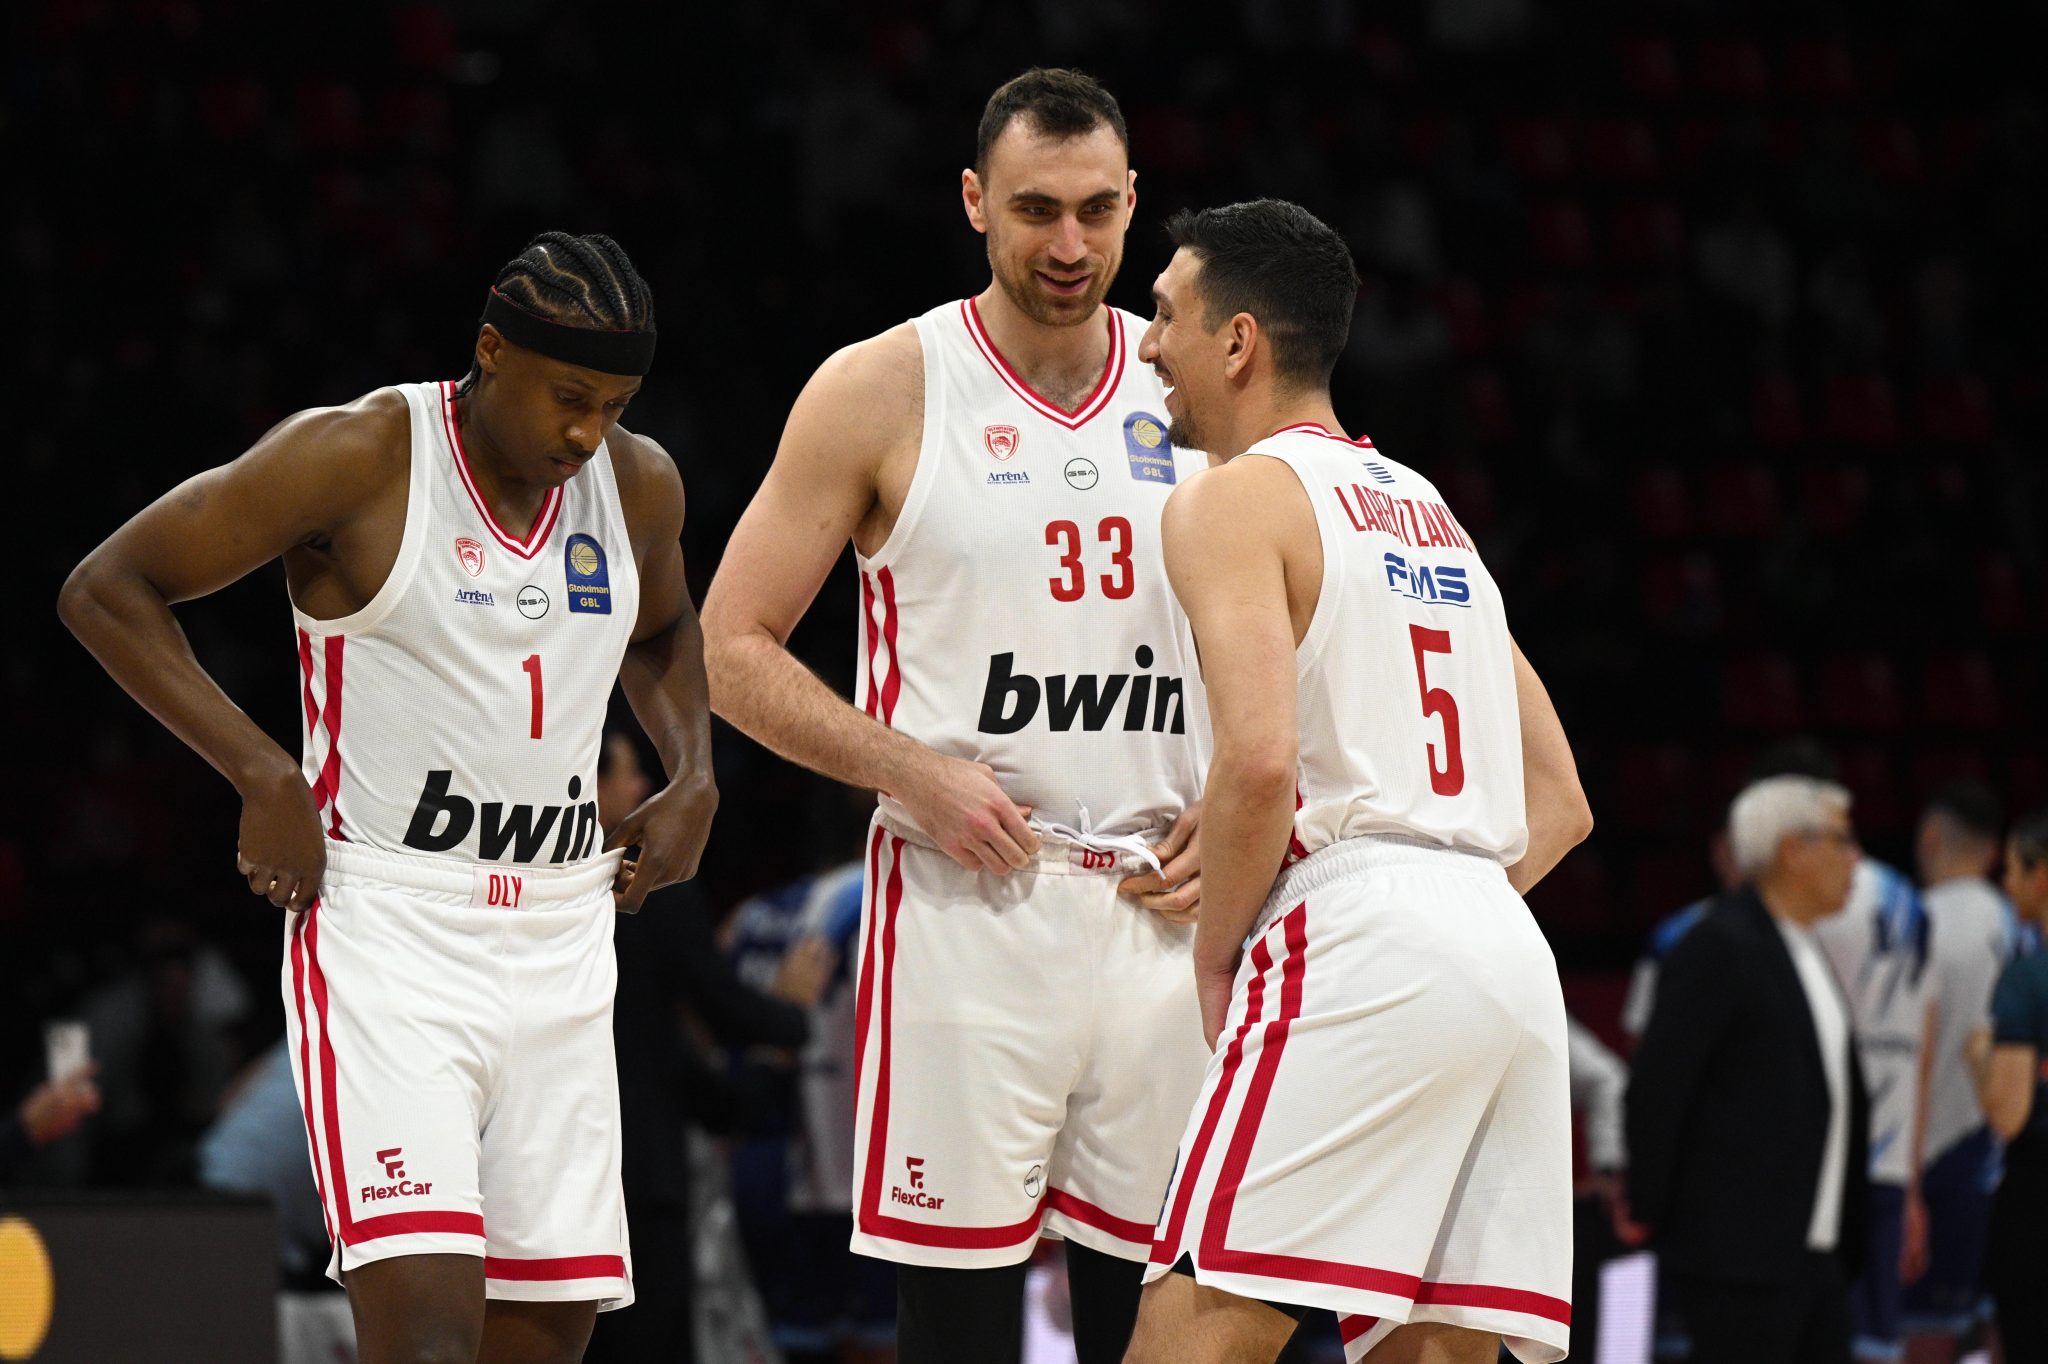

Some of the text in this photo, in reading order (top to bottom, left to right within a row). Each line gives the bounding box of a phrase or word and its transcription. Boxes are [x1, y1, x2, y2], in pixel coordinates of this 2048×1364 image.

[1142, 466, 1165, 478] GBL
[1334, 483, 1473, 553] LARENTZAKI
[1045, 516, 1136, 603] 33
[1384, 552, 1470, 603] FMS
[518, 598, 547, 606] GSA
[580, 597, 601, 608] GBL
[522, 653, 544, 740] 1
[977, 644, 1186, 736] bwin
[1408, 623, 1465, 797] 5
[401, 769, 598, 864] bwin
[361, 1180, 433, 1204] FlexCar
[891, 1186, 945, 1211] FlexCar
